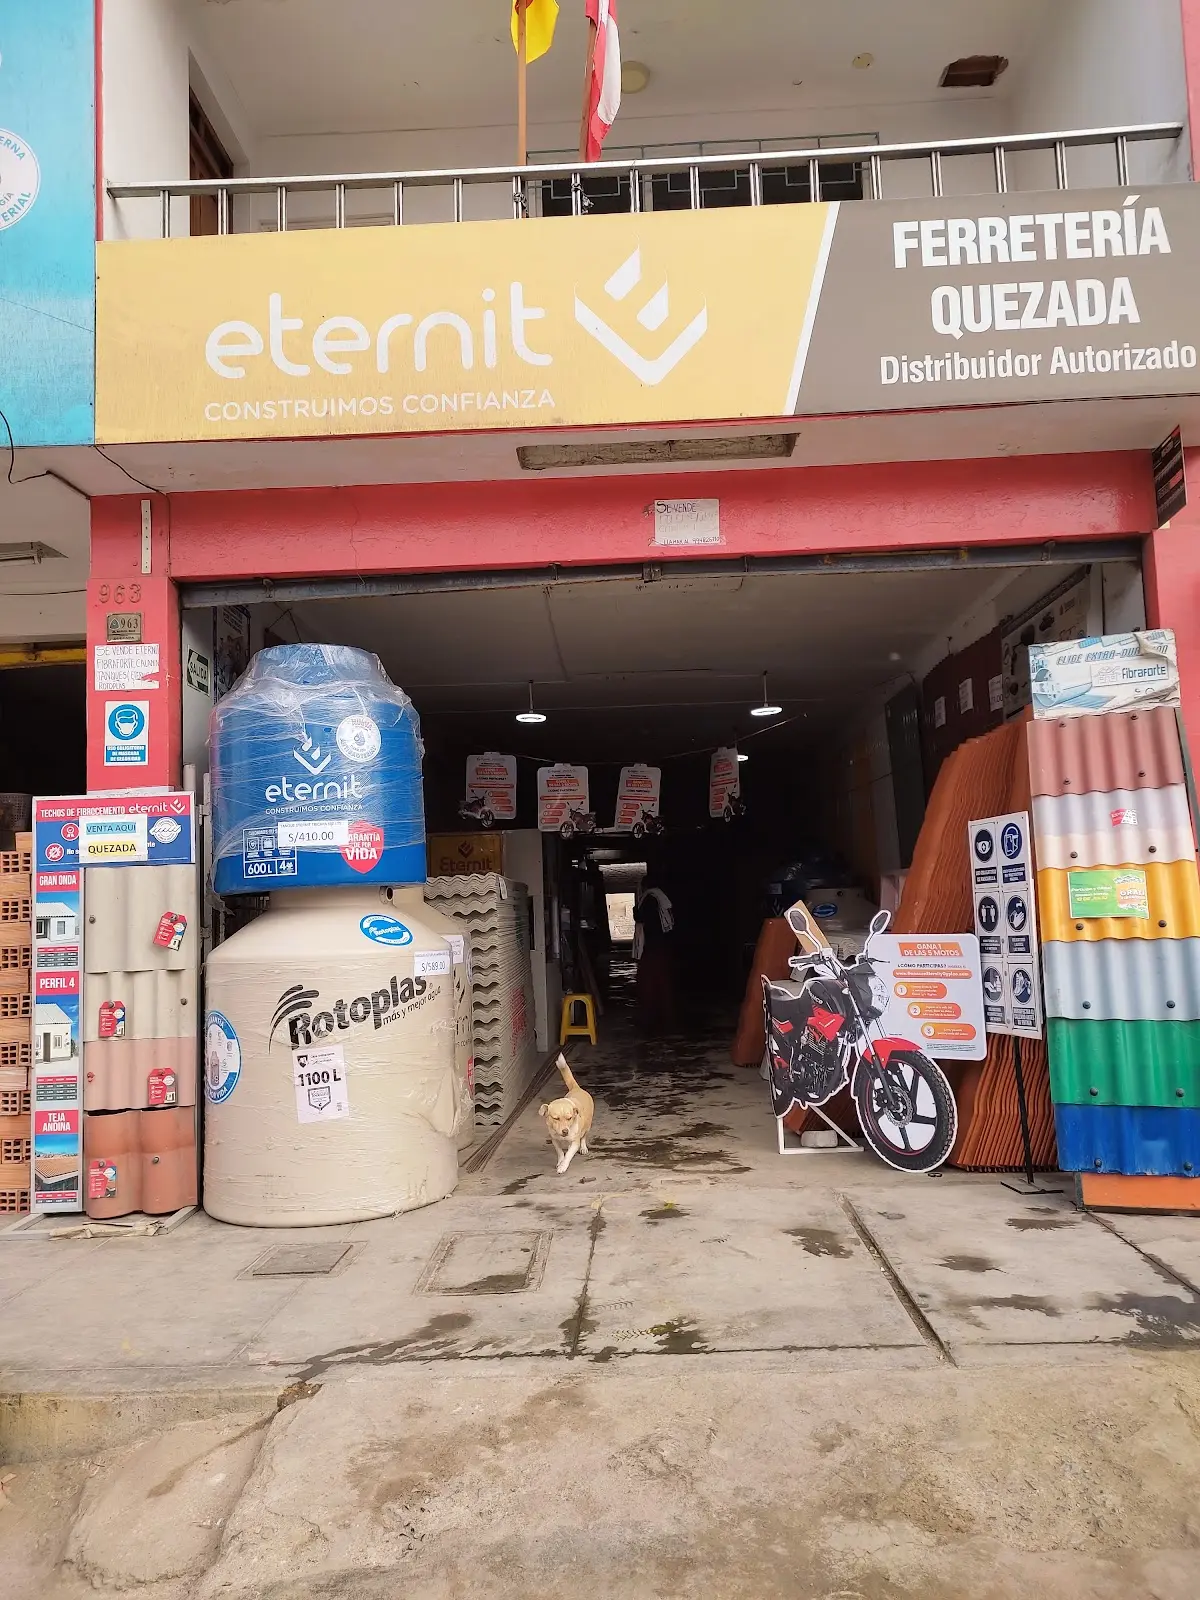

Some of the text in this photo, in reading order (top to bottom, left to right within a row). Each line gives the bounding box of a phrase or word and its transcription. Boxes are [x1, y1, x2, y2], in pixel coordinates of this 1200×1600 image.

[893, 195, 1171, 268] FERRETERÍA
[931, 277, 1140, 339] QUEZADA
[205, 282, 553, 379] eternit
[880, 341, 1197, 384] Distribuidor Autorizado
[204, 388, 556, 421] CONSTRUIMOS CONFIANZA
[98, 583, 142, 605] 963
[120, 617, 139, 629] 963
[265, 774, 363, 802] eternit
[40, 801, 169, 818] TECHOS DE FIBROCEMENTO eternit
[265, 804, 363, 815] CONSTRUIMOS CONFIANZA
[86, 825, 114, 833] VENTA
[288, 832, 334, 844] S/410.00
[348, 832, 381, 842] ARANTÍA
[88, 843, 137, 854] QUEZADA
[345, 847, 378, 860] VIDA
[39, 874, 77, 886] GRAN ONDA
[40, 976, 75, 989] PERFIL 4
[288, 975, 427, 1051] Rotoplas
[383, 1011, 401, 1026] más
[407, 997, 427, 1013] mejor
[297, 1068, 342, 1086] 1100 L
[48, 1112, 66, 1122] TEJA
[43, 1122, 71, 1132] ANDINA
